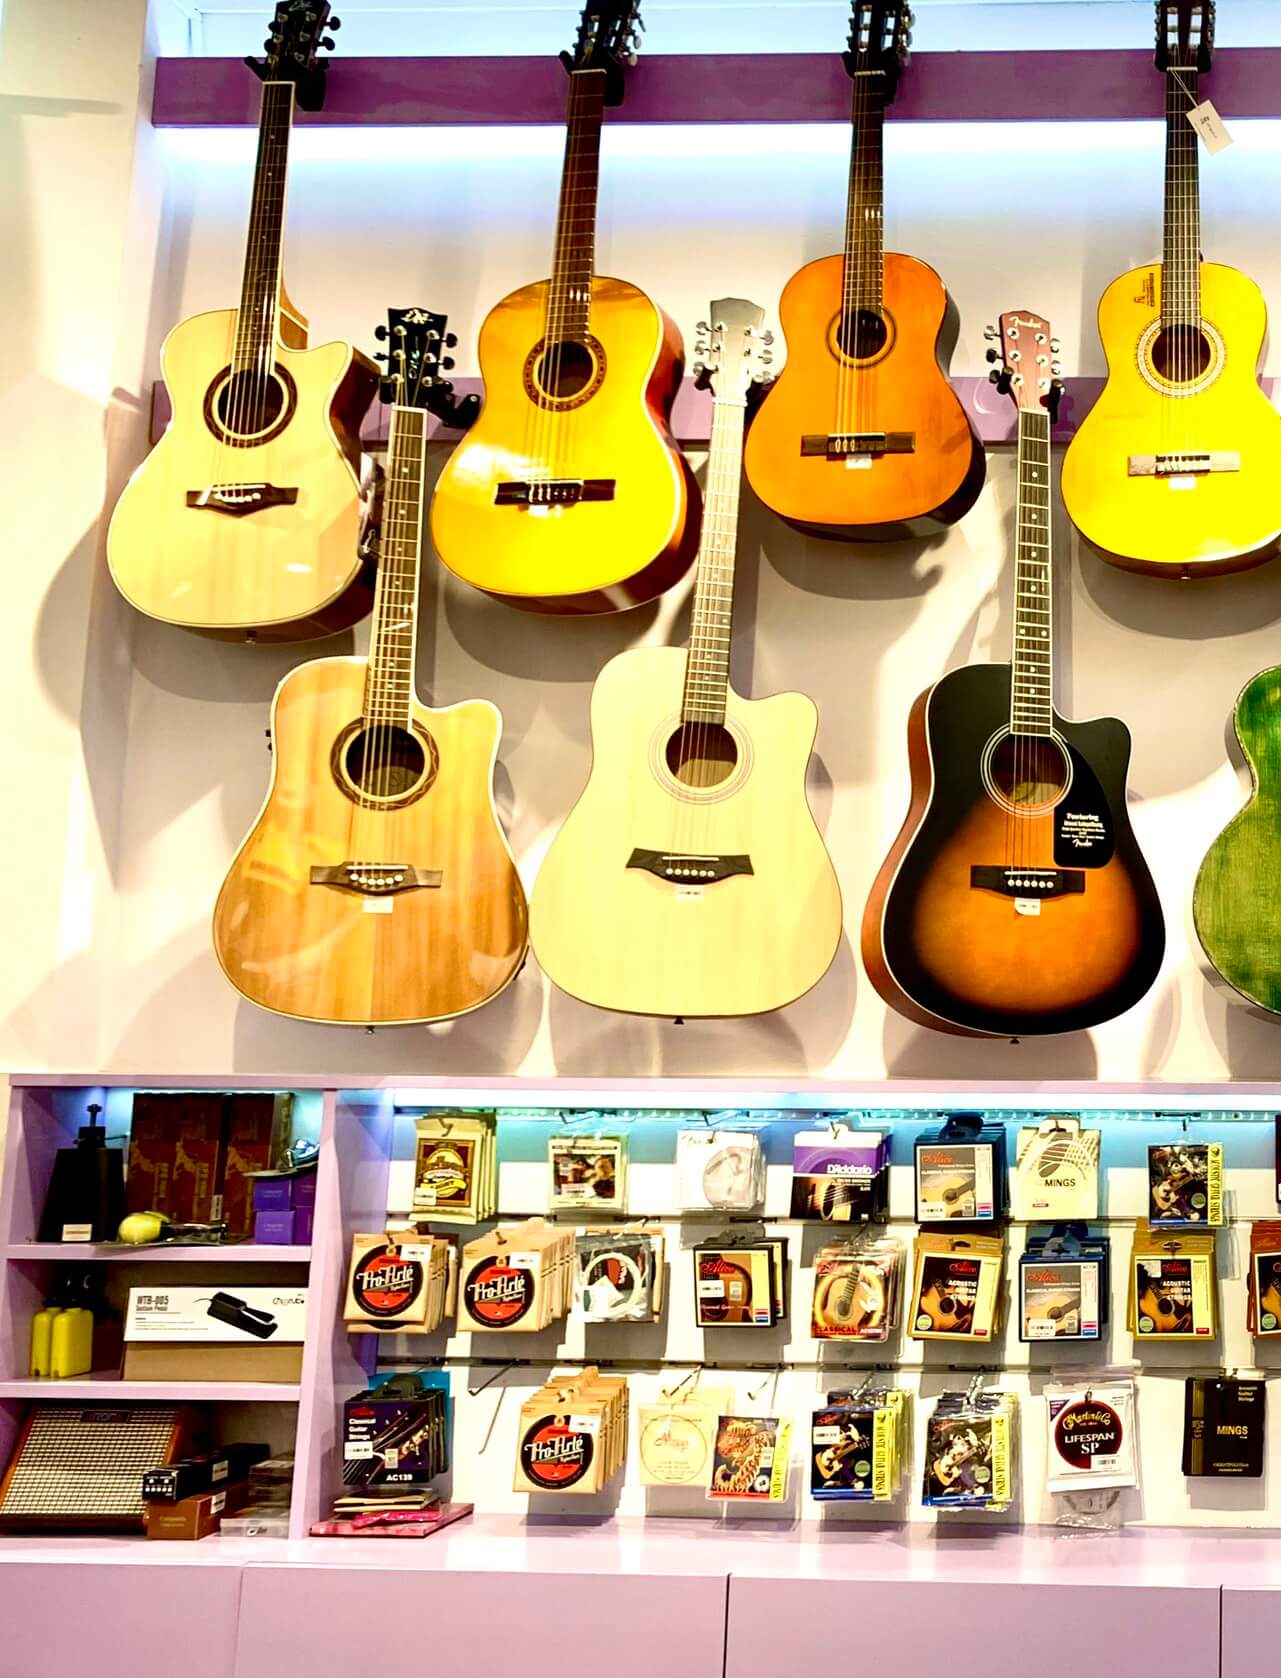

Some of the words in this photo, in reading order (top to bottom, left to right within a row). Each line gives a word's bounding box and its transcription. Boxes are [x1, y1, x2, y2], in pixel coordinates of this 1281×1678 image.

[1044, 1178, 1076, 1188] MINGS
[137, 1295, 169, 1305] WTB-005
[1216, 1425, 1249, 1436] MINGS
[1065, 1432, 1115, 1443] LIFESPAN
[1080, 1442, 1100, 1455] SP
